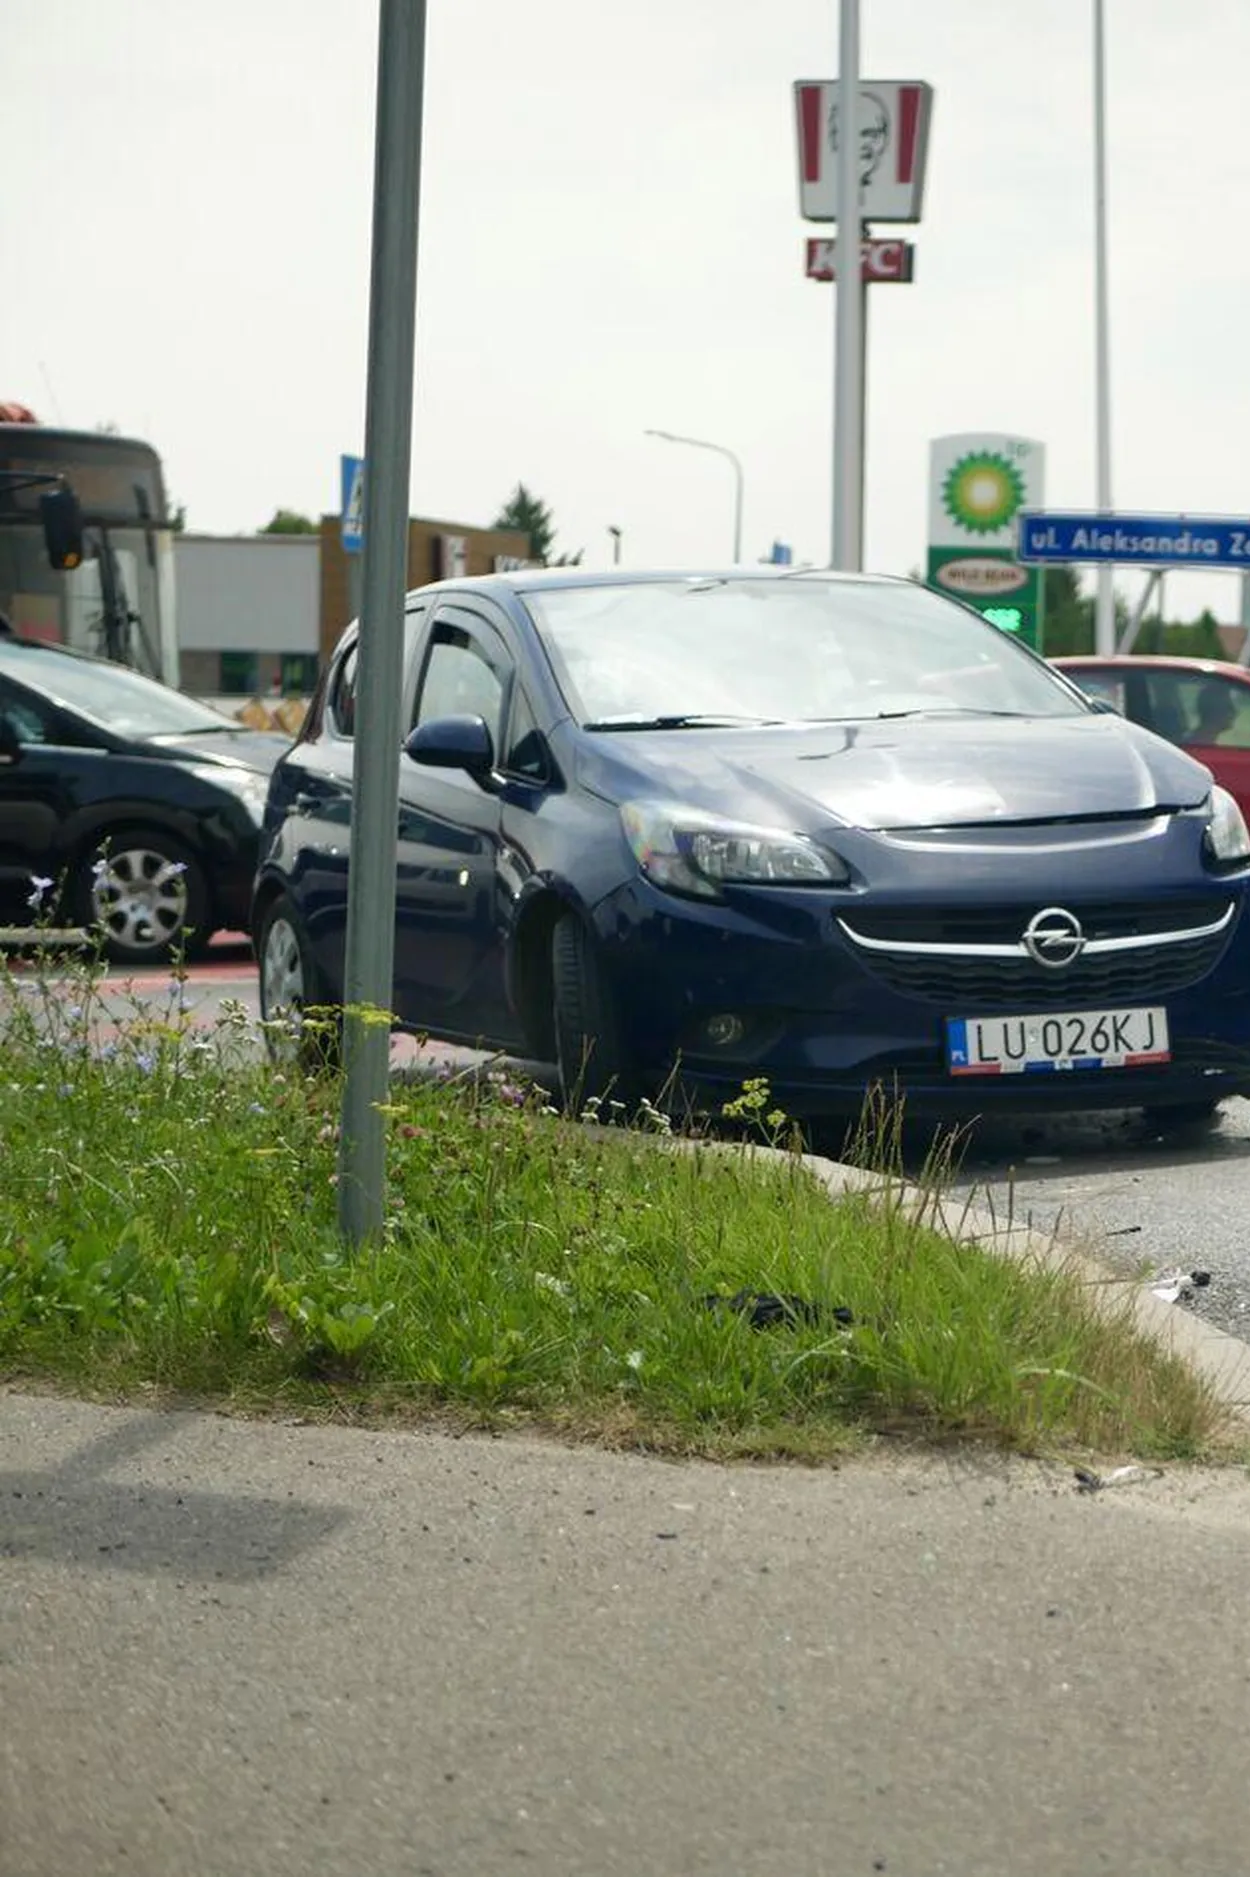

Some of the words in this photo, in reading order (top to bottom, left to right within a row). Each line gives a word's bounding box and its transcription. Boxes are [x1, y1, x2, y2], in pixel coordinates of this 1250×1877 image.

[810, 242, 898, 274] KC
[1031, 527, 1060, 549] ul.
[1071, 526, 1218, 555] Aleksandra
[976, 1021, 1027, 1061] LU
[1042, 1012, 1156, 1058] 026KJ
